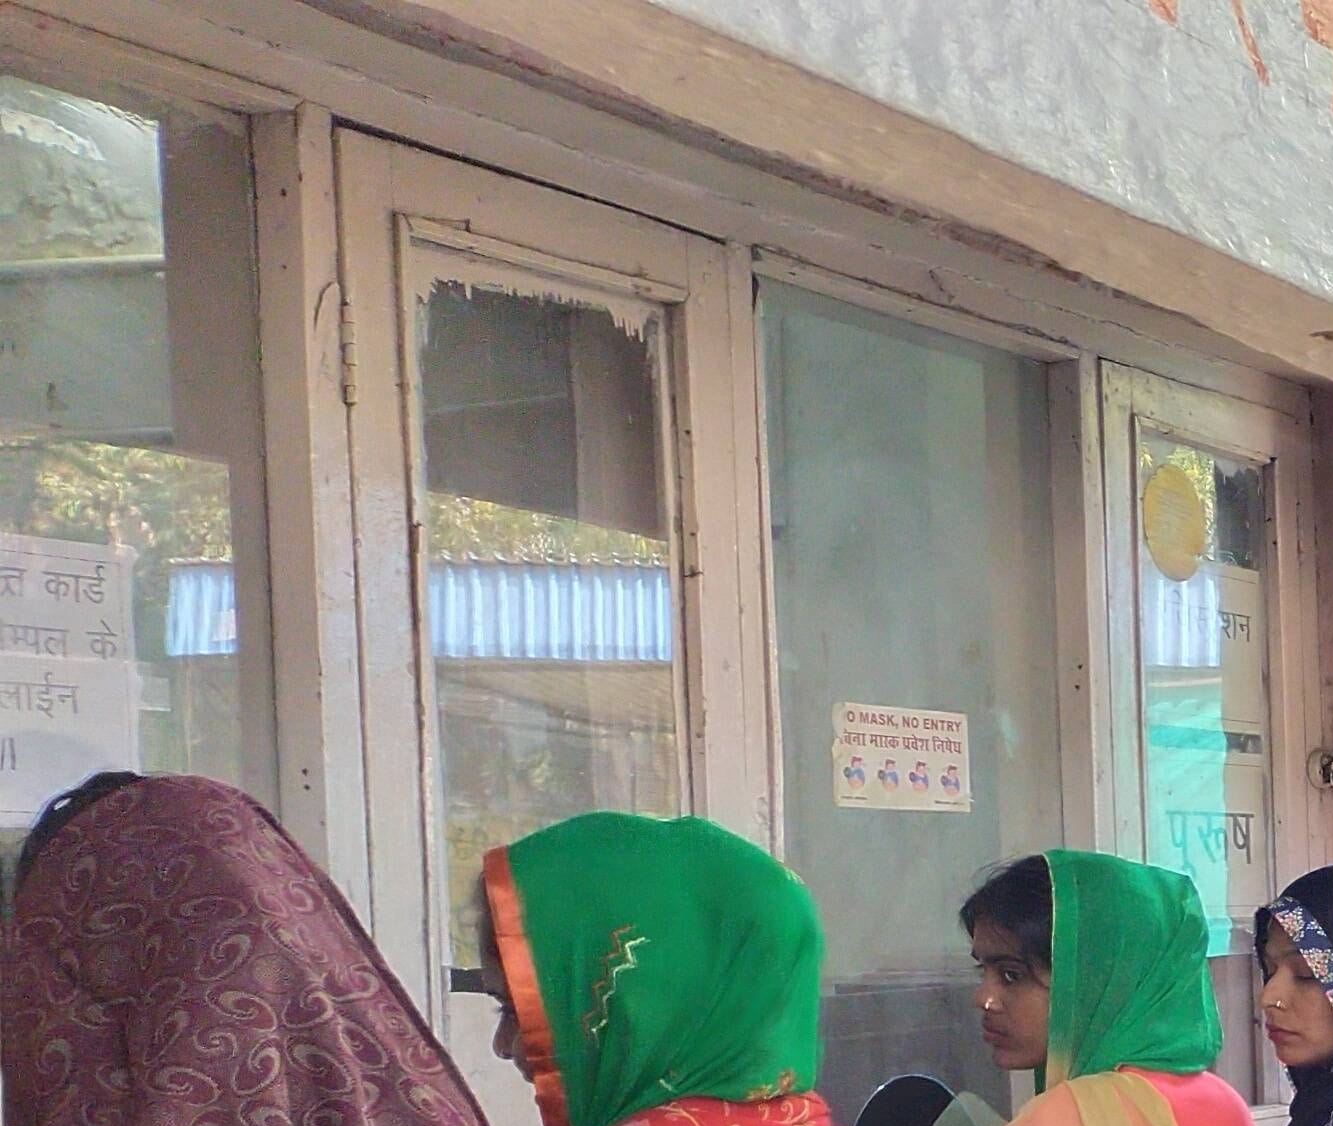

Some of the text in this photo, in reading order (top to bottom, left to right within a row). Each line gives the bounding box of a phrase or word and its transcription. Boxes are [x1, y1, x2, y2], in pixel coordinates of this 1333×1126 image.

[42, 564, 106, 604] कार्ड
[86, 620, 118, 660] के
[860, 712, 898, 729] MASK,
[902, 716, 919, 728] NO
[923, 718, 962, 732] ENTRY
